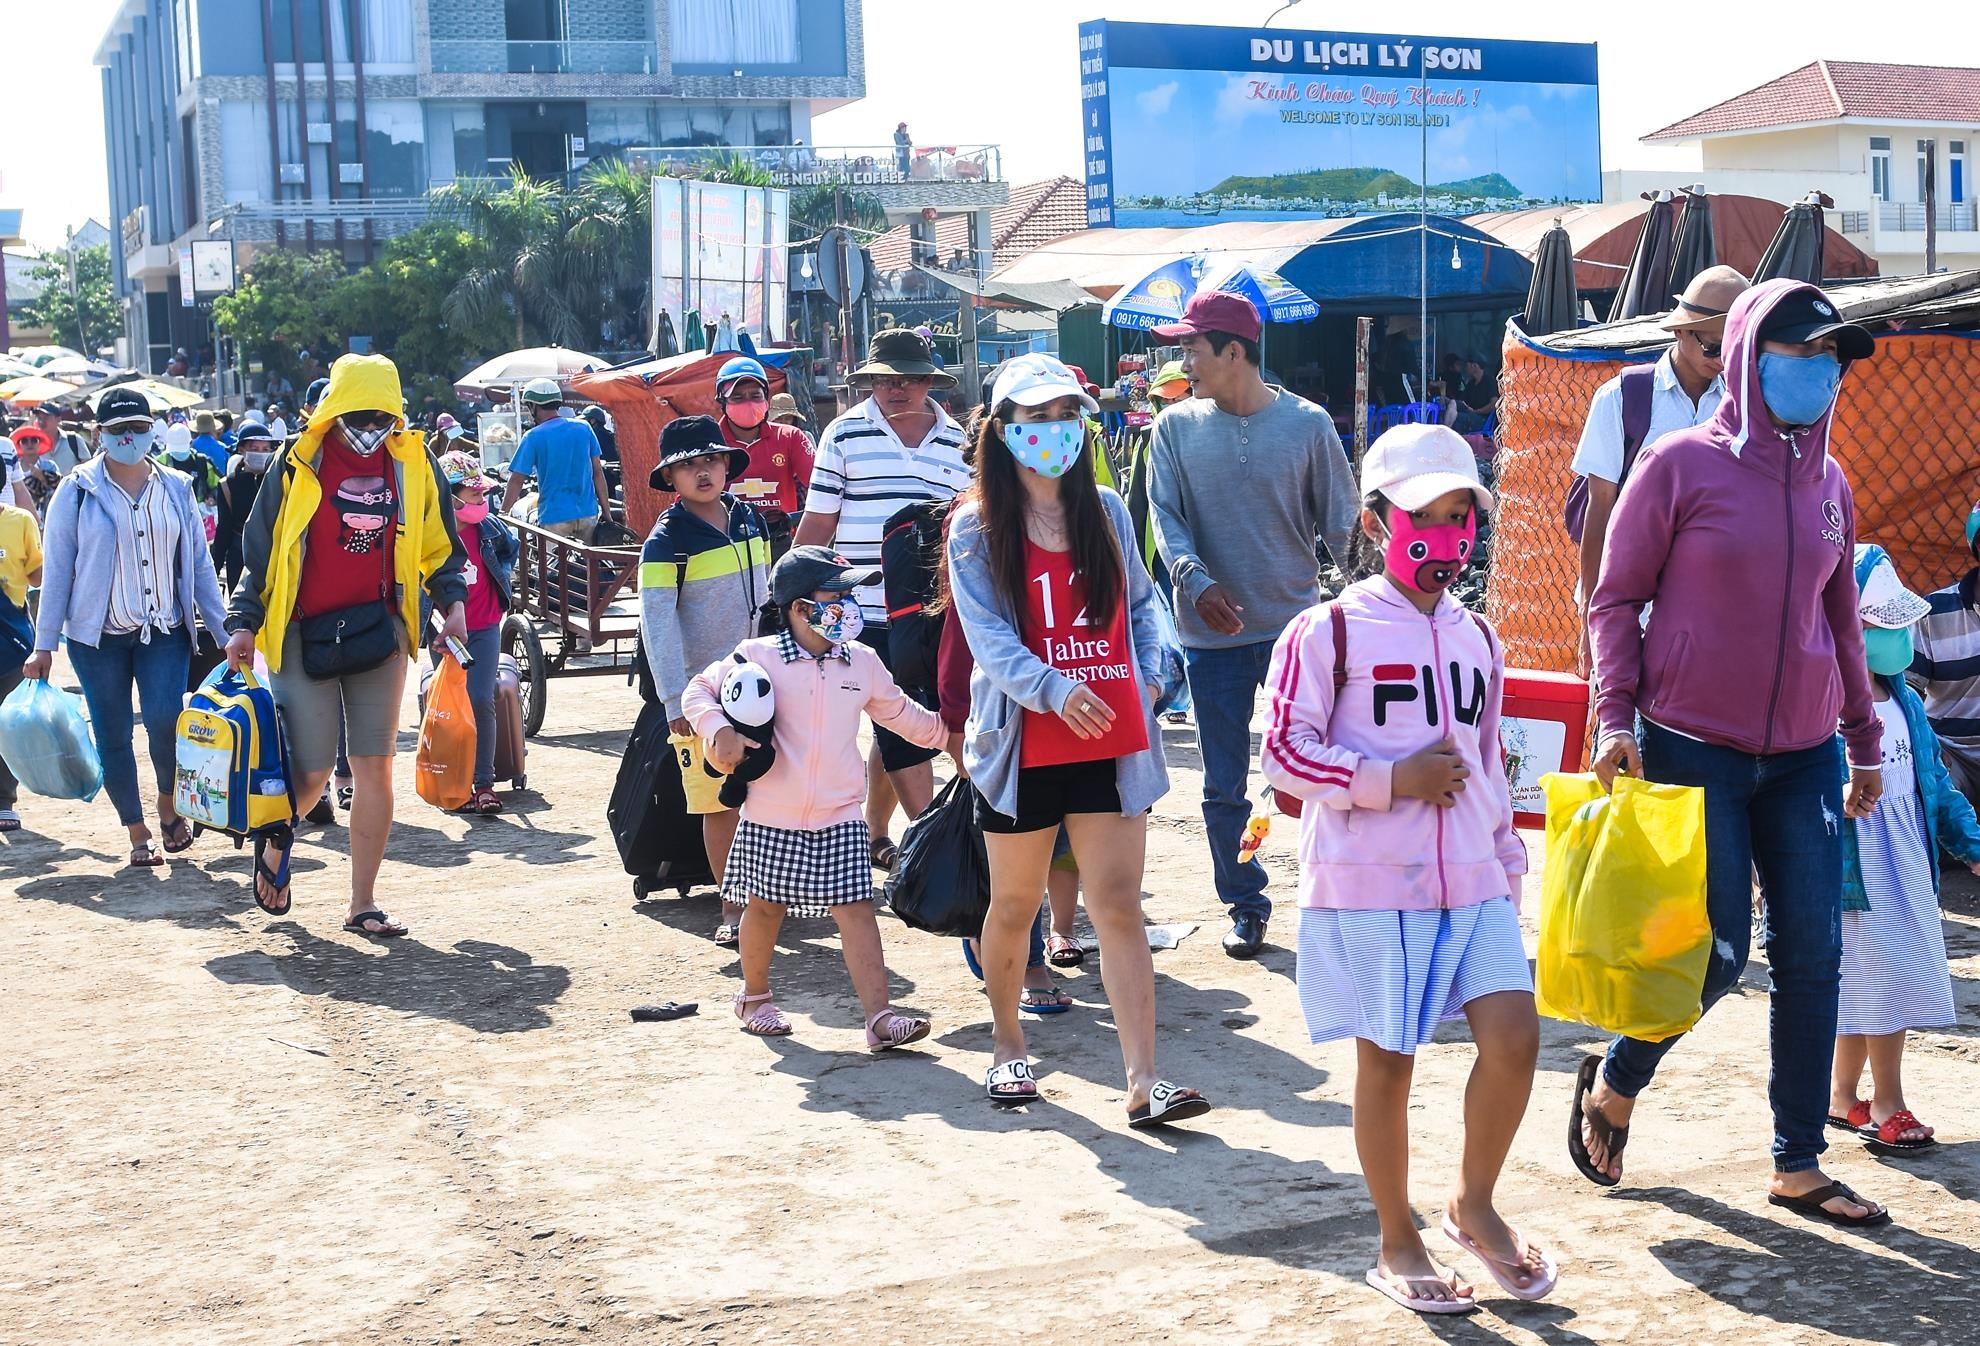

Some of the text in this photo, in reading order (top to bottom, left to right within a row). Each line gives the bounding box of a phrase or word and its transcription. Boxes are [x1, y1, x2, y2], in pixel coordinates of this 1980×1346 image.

[1250, 39, 1482, 70] DU LỊCH LÝ SƠN
[1360, 84, 1399, 107] Quý
[1280, 110, 1340, 125] WELCOME
[1342, 111, 1359, 125] TO
[1361, 112, 1376, 125] LY
[1377, 113, 1401, 126] SON
[1403, 114, 1443, 127] ISLND
[791, 172, 849, 185] NGUYN
[853, 171, 905, 184] COFFEE
[1116, 312, 1137, 325] 0917
[1139, 315, 1156, 328] 666
[1273, 303, 1316, 320] 0917 666 999
[1043, 634, 1110, 667] Jahre
[1372, 661, 1486, 730] FILA
[681, 748, 692, 768] 3
